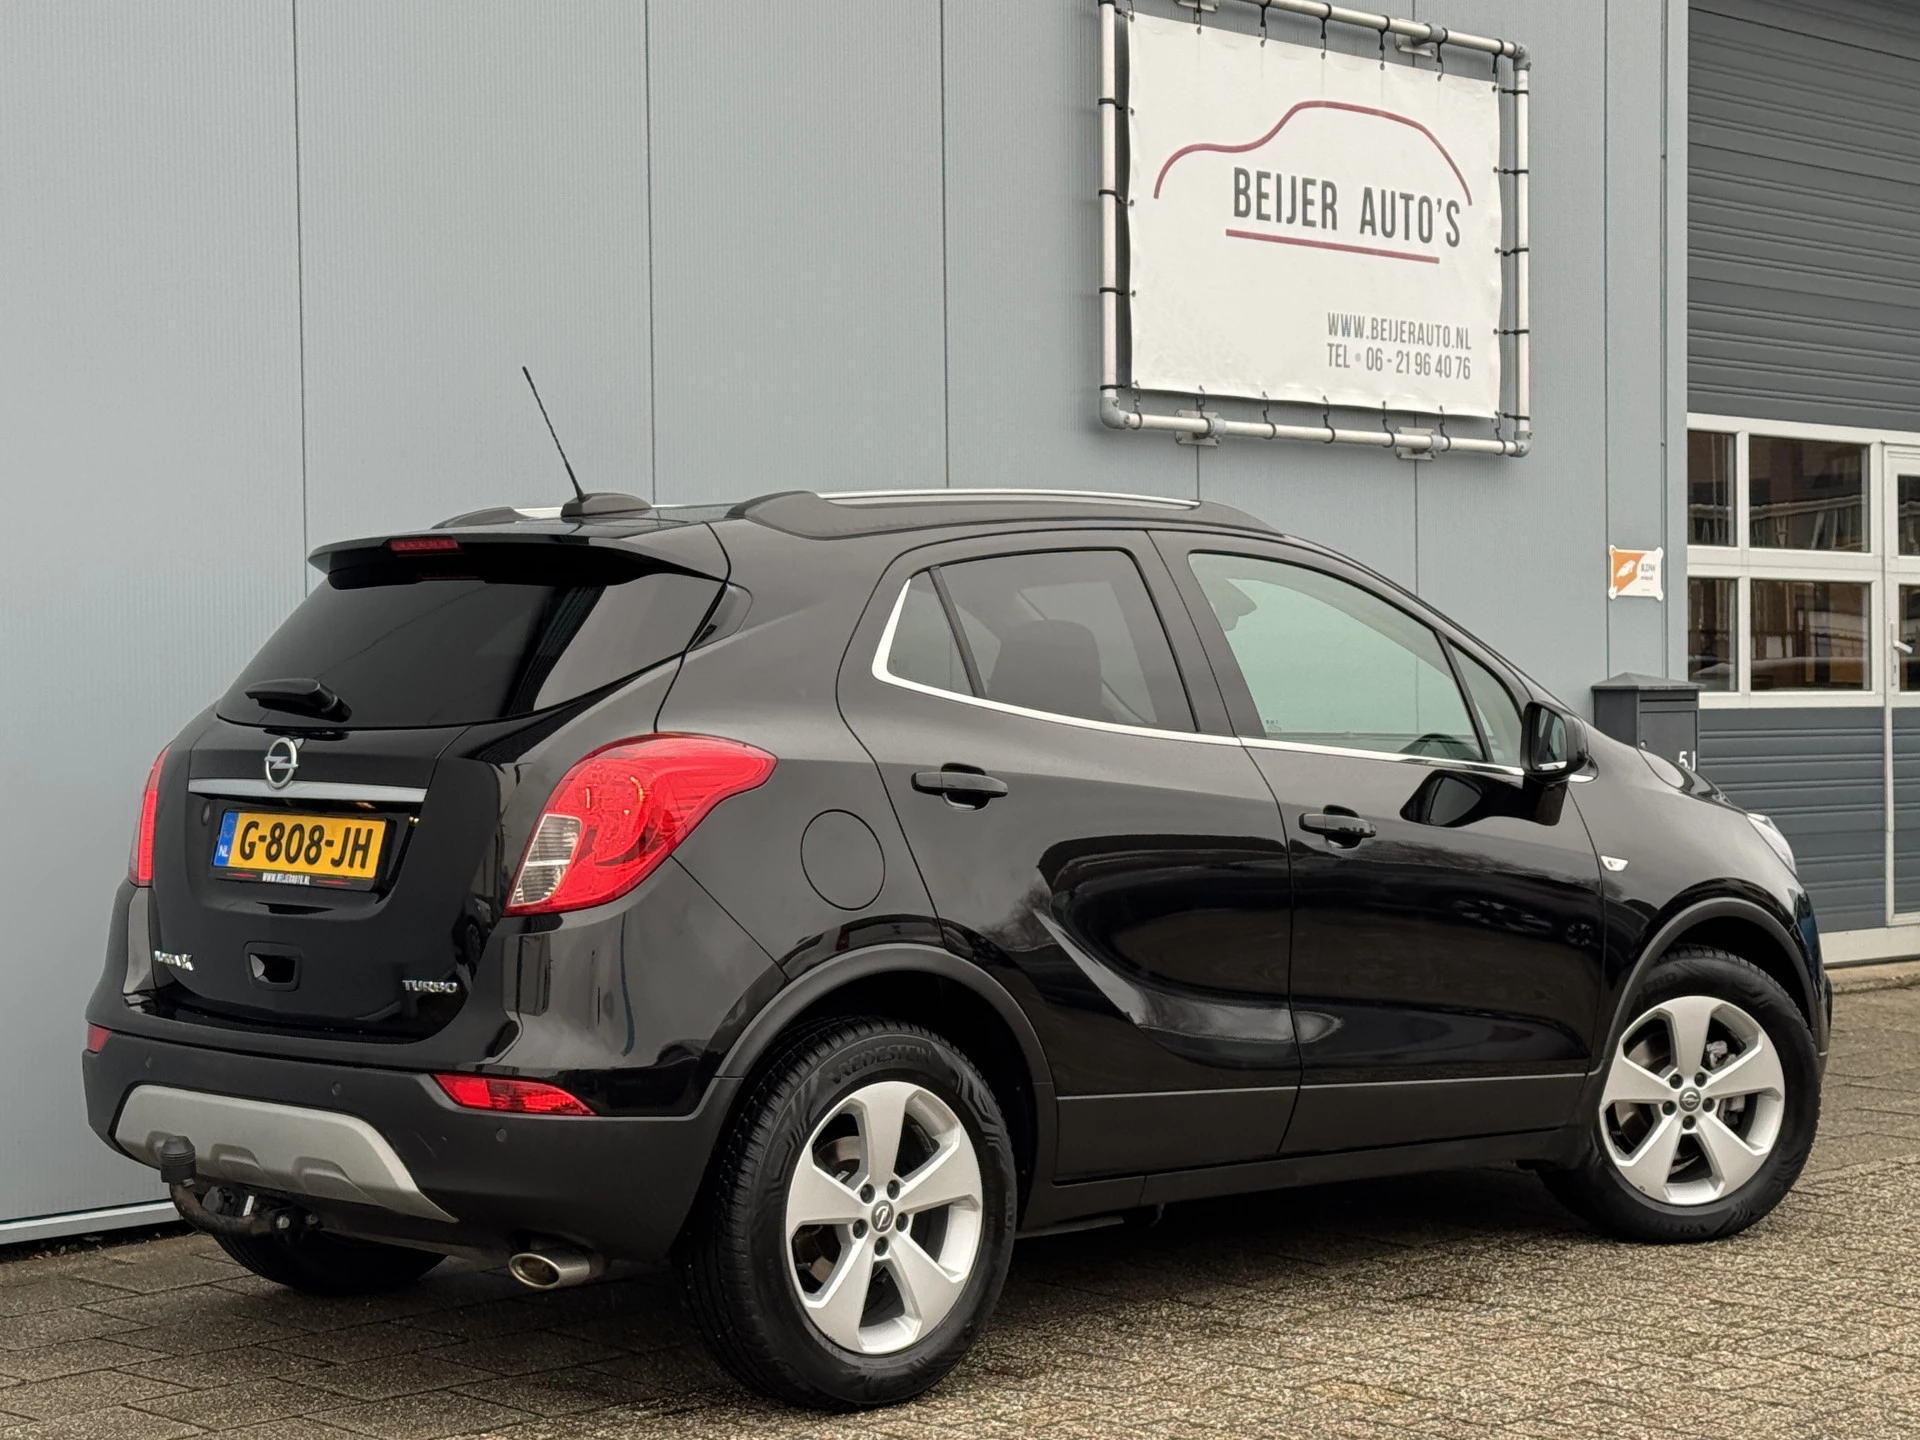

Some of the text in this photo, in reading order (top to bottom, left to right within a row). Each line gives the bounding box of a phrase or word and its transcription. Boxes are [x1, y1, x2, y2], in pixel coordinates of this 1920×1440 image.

[1234, 167, 1461, 248] BEIJER AUTO'S
[1327, 312, 1472, 350] WWW.BEIJERAUTO.NL
[1327, 343, 1350, 368] TEL
[1366, 347, 1383, 371] 06
[1396, 350, 1410, 374] 21
[1414, 352, 1431, 376] 96
[1435, 354, 1452, 378] 40
[1455, 356, 1471, 380] 76
[218, 845, 229, 858] NL
[239, 820, 374, 869] G-808-JH
[402, 980, 458, 993] TURBO
